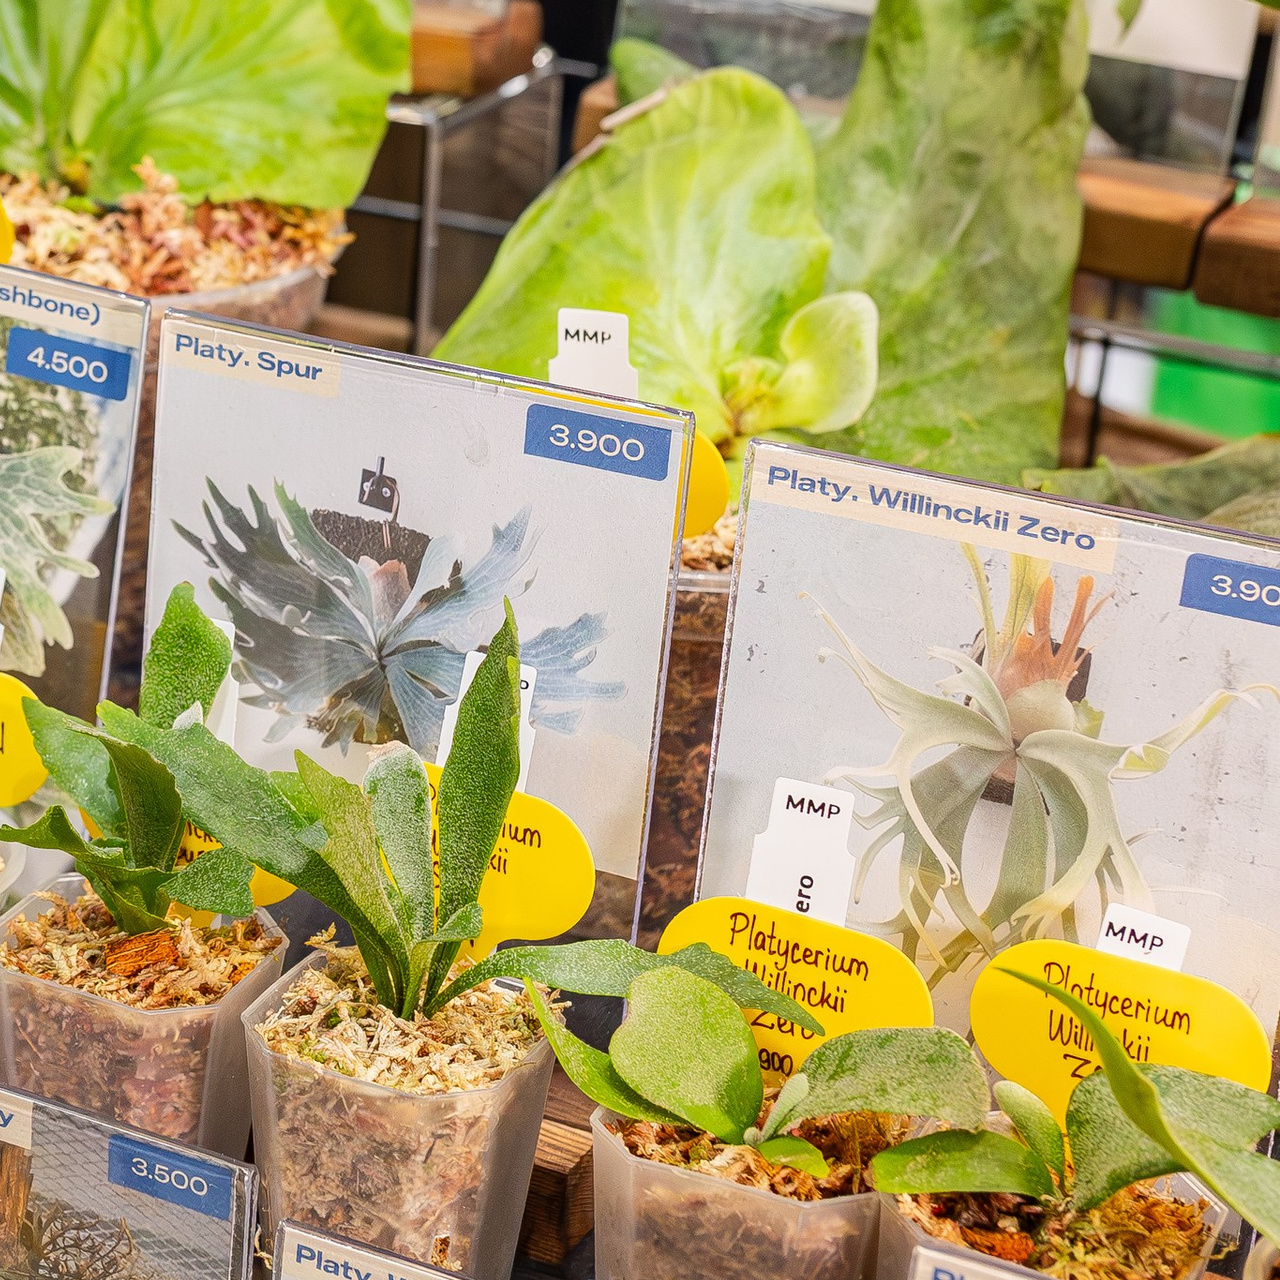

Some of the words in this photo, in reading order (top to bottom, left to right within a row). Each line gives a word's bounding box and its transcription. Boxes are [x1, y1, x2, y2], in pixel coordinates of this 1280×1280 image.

[563, 327, 613, 345] MMP
[26, 345, 108, 384] 4.500
[174, 332, 251, 372] Platy.
[256, 350, 323, 383] Spur
[548, 423, 646, 463] 3.900
[767, 464, 858, 504] Platy.
[868, 484, 1010, 534] Willinckii
[1016, 514, 1097, 552] Zero
[1209, 573, 1280, 608] 3.90
[785, 793, 842, 820] MMP
[796, 873, 814, 913] ero
[729, 912, 869, 982] Platycerium
[1104, 920, 1165, 952] MMP
[1043, 961, 1192, 1036] Platycerium
[758, 1047, 795, 1078] 900
[130, 1157, 208, 1198] 3.500
